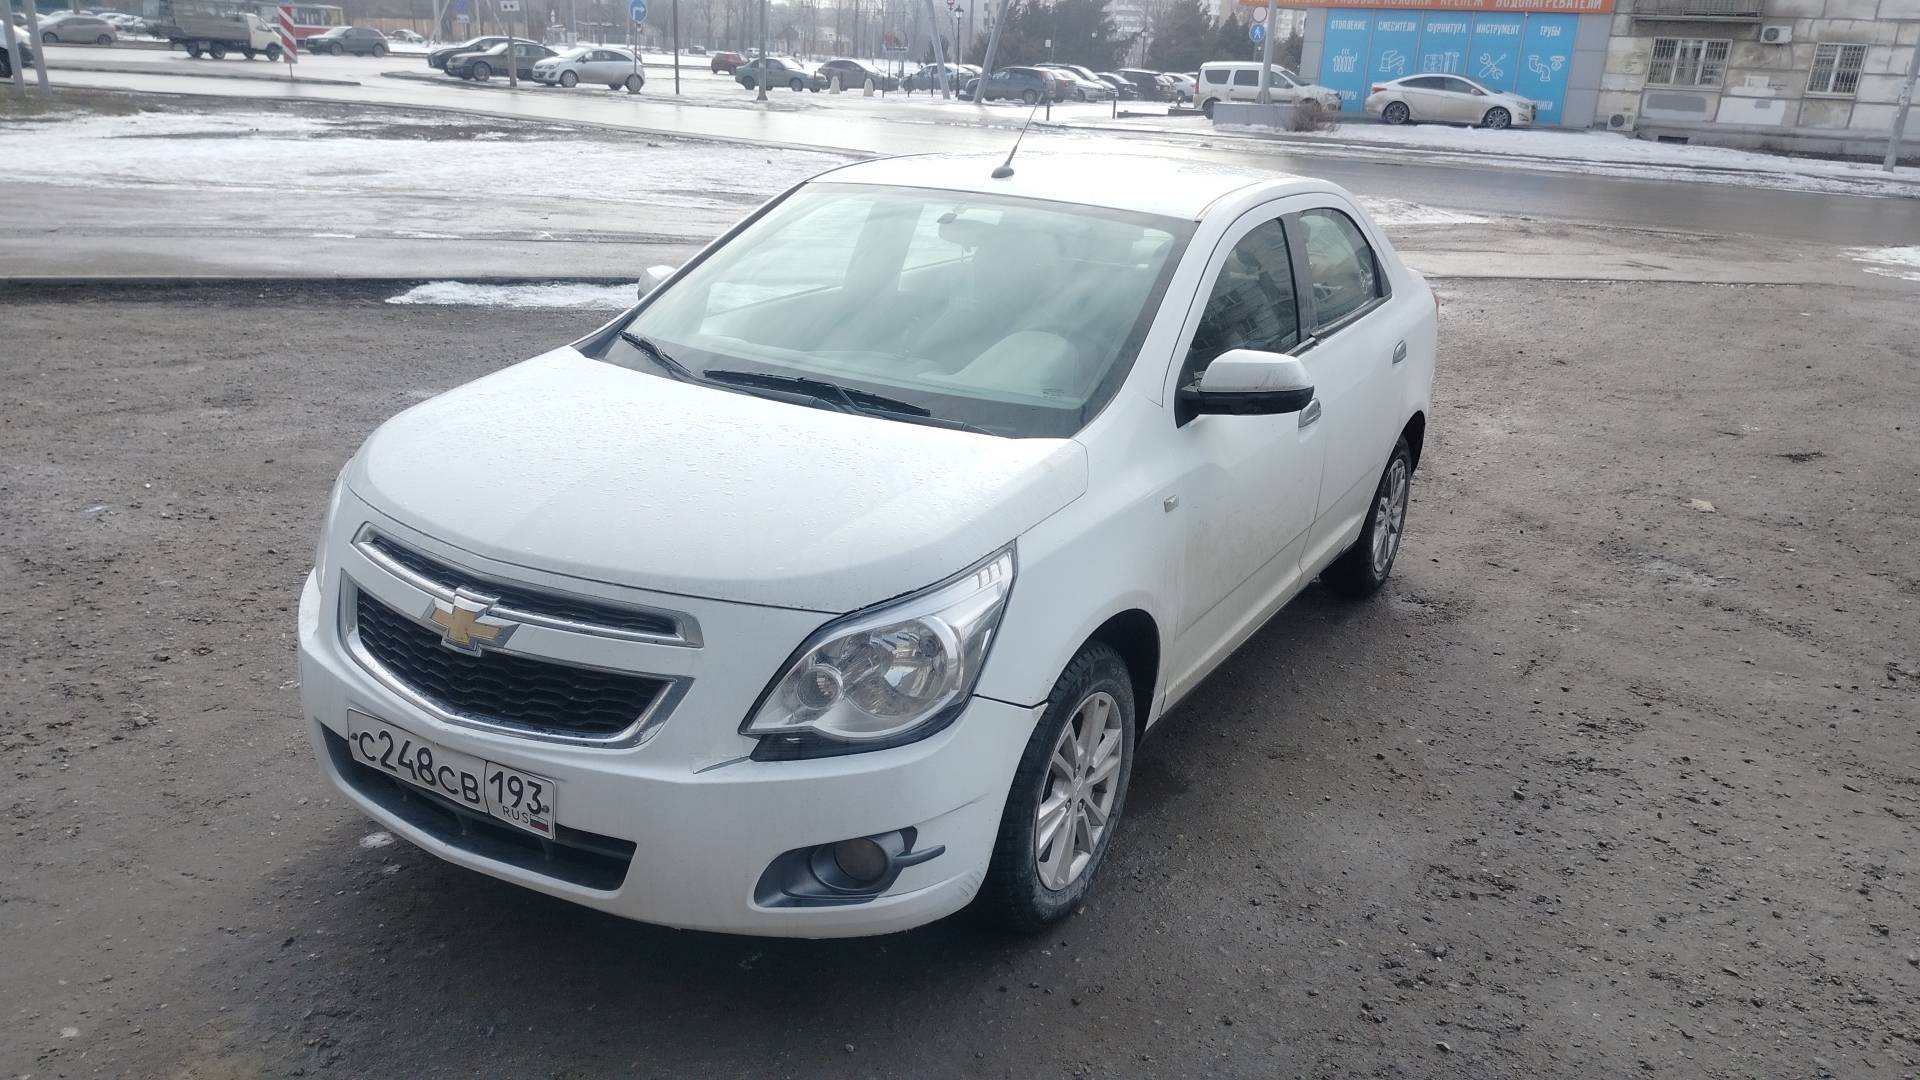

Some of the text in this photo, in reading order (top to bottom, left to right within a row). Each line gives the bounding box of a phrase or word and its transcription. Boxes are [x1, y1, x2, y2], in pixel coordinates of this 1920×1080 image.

[1495, 0, 1602, 9] ВОДОНАГРЕВАТЕЛИ
[1331, 20, 1366, 31] ОТОПЛЕНИЕ
[1378, 21, 1417, 32] СМЕСИТЕЛИ
[1426, 23, 1467, 35] ФУРНИТУРА
[1475, 24, 1520, 36] ИНСТРУМЕНТ
[1539, 25, 1562, 37] ТРУБЫ
[358, 730, 481, 804] С248СВ
[489, 771, 543, 815] 193
[502, 805, 529, 824] RUS
